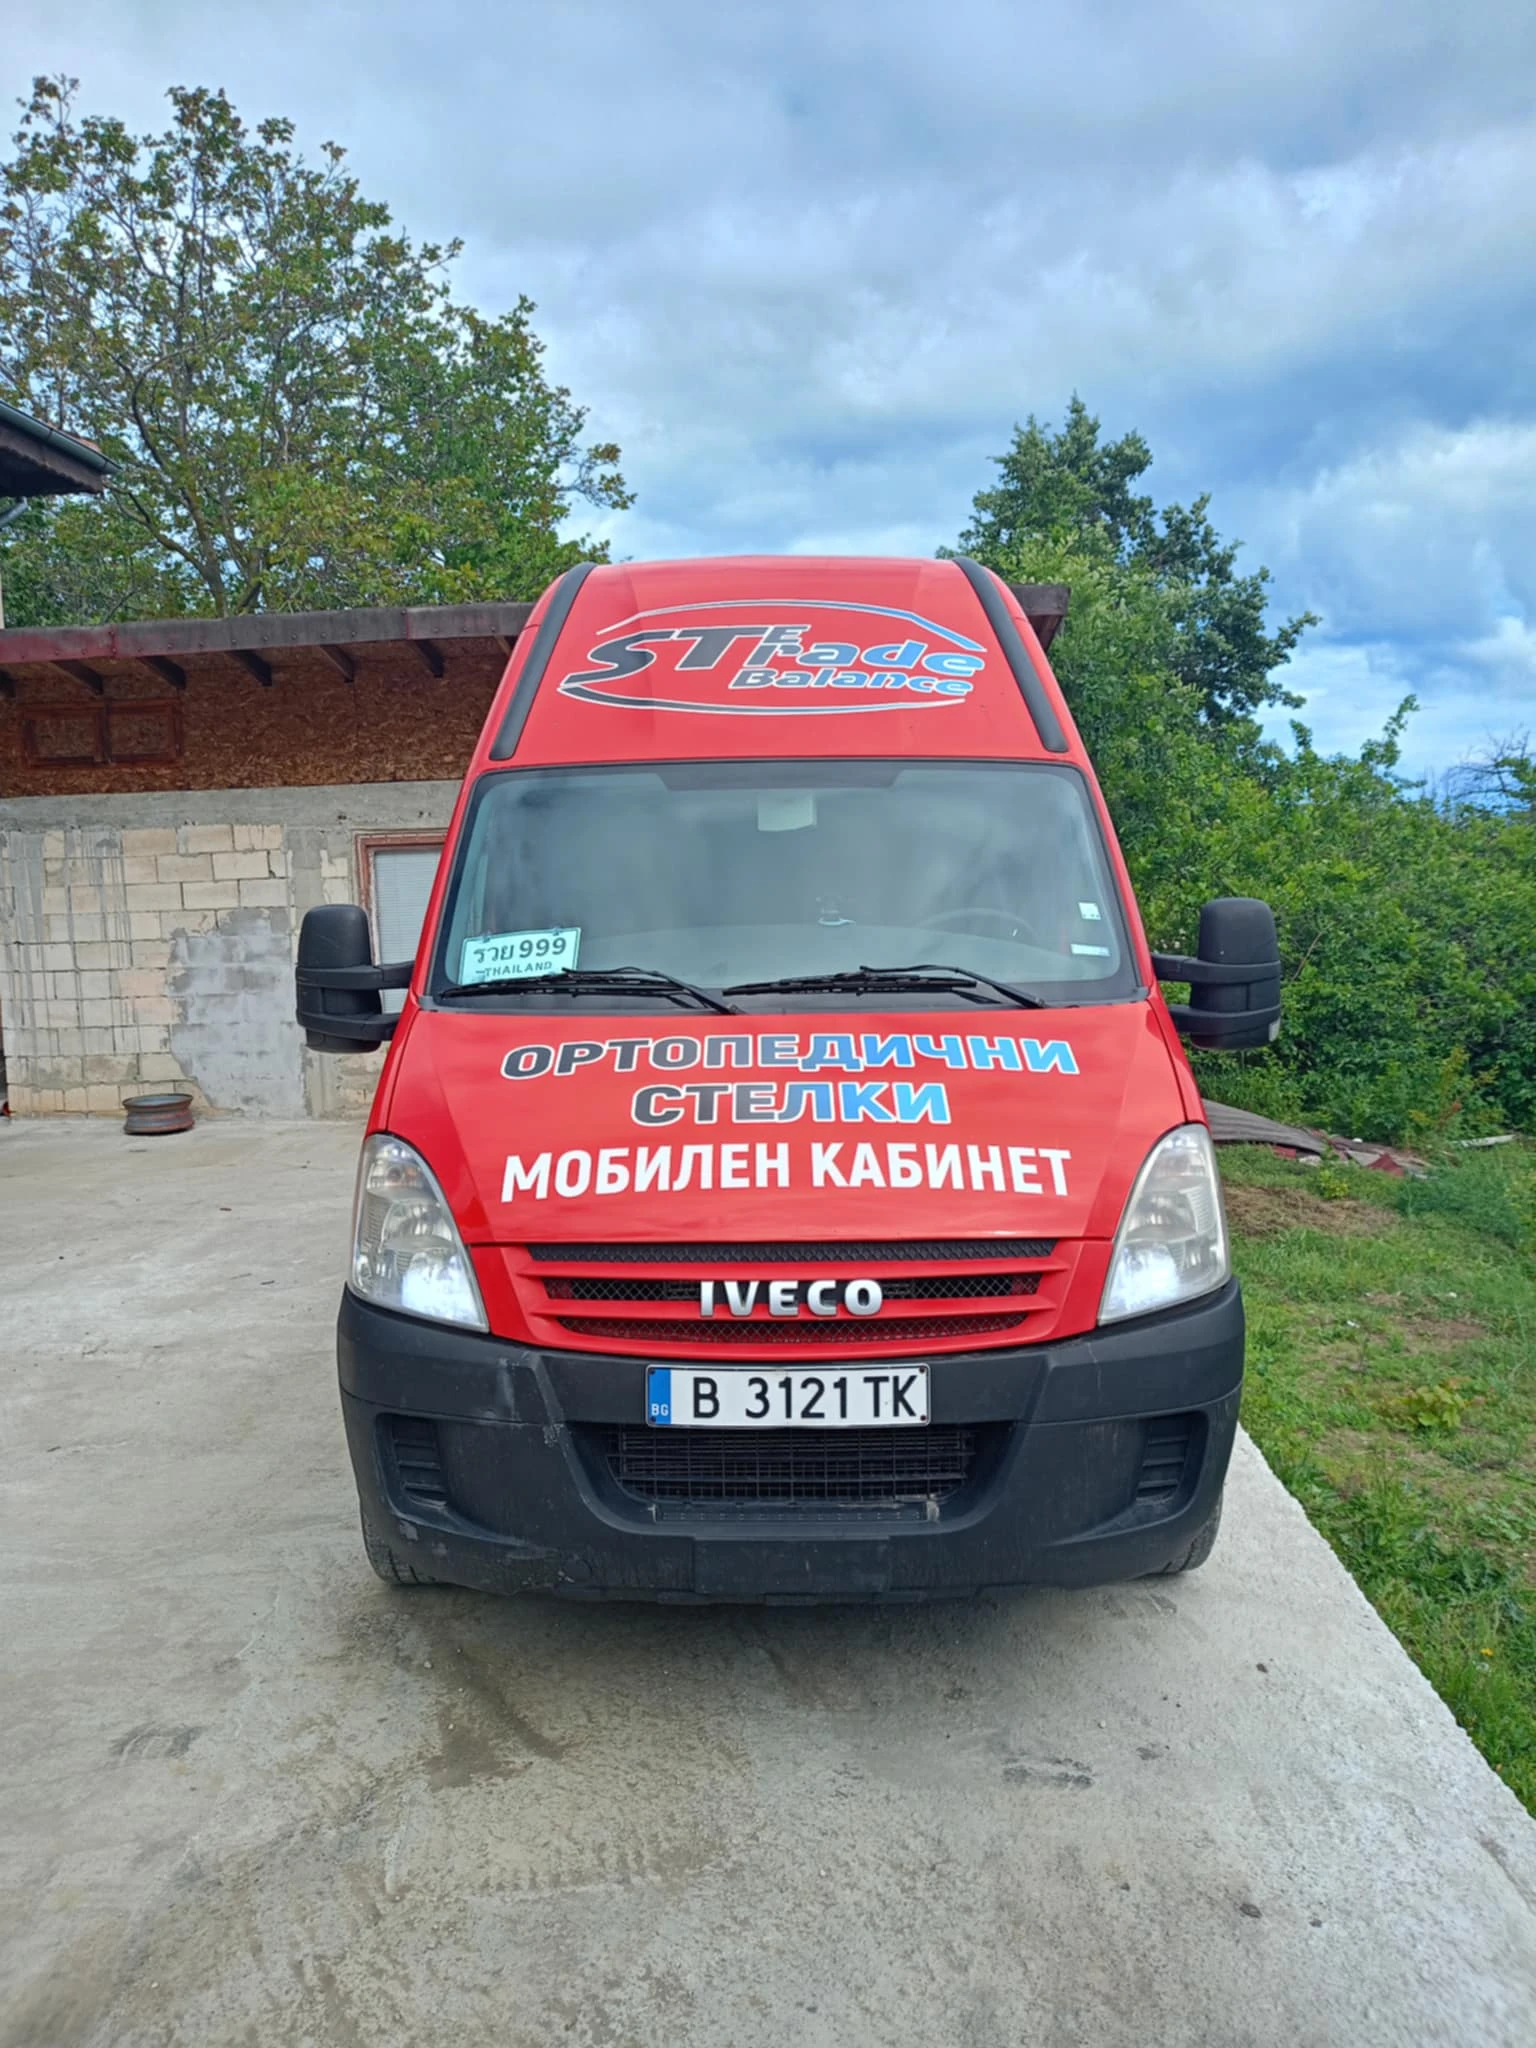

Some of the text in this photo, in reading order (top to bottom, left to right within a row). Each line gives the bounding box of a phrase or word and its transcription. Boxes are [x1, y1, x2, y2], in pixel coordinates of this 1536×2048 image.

[728, 667, 973, 695] Balance
[519, 937, 567, 959] 999
[484, 961, 553, 977] THAILAND
[500, 1034, 1081, 1079] ОРТОПЕДИЧНИ
[631, 1081, 952, 1126] СТЕЛКИ
[500, 1142, 1072, 1203] МОБИЛЕН КАБИНЕТ
[700, 1280, 883, 1316] IVECO
[650, 1403, 670, 1417] BG
[692, 1374, 918, 1420] B 3121 TK
